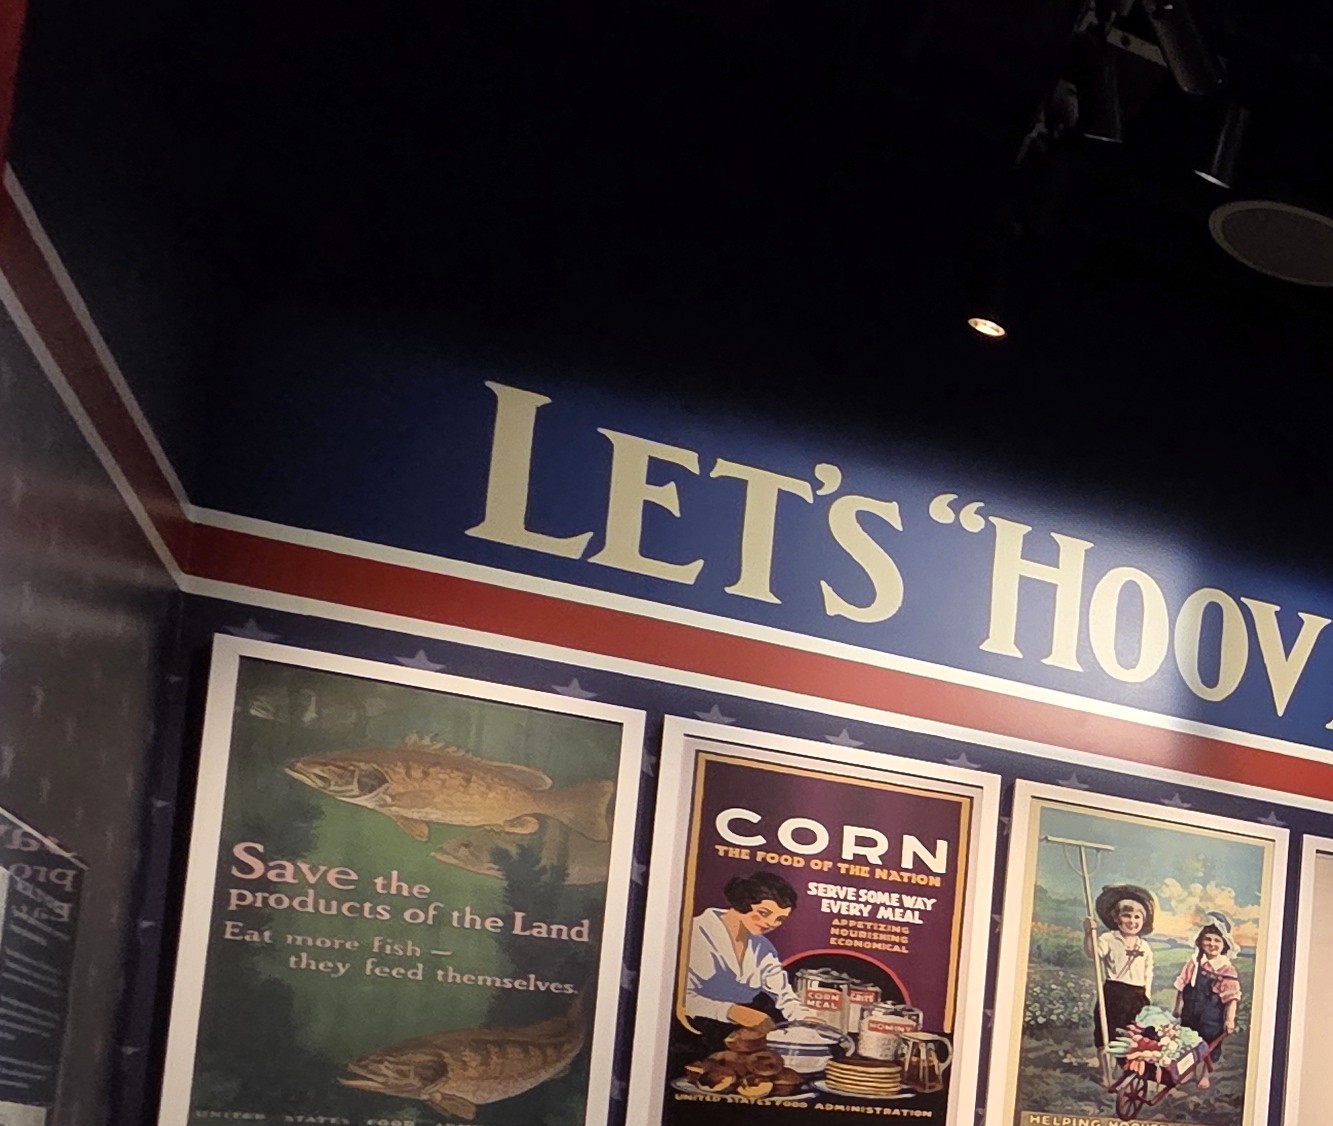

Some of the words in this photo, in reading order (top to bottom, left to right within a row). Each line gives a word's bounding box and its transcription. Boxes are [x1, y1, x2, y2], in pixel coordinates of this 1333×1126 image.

[715, 807, 948, 874] CORN
[230, 841, 359, 890] Save
[373, 870, 431, 899] the
[715, 844, 750, 860] THE
[756, 851, 805, 868] FOOD
[810, 859, 834, 871] OF
[837, 862, 870, 878] THE
[875, 868, 941, 887] NATION
[807, 881, 857, 902] SERVE
[859, 888, 899, 906] SOME
[901, 892, 937, 912] WAY
[228, 888, 392, 920] products
[403, 902, 444, 925] of
[451, 906, 505, 933] the
[512, 912, 591, 943] Land
[821, 898, 873, 918] EVERY
[876, 905, 924, 925] MEAL
[223, 921, 273, 943] Eat
[286, 933, 359, 951] more
[372, 937, 421, 957] fish
[830, 927, 909, 945] NOURISHING
[831, 918, 910, 935] APPETIZING
[829, 937, 909, 954] ECONOMICAL
[289, 953, 350, 978] they
[365, 959, 424, 980] feed
[437, 968, 579, 995] themselves.
[806, 999, 838, 1010] MEAL
[807, 991, 840, 1001] CORN
[674, 1092, 721, 1104] UNITED
[775, 1098, 809, 1109] FOOD
[814, 1102, 933, 1118] ADMINISTRATION
